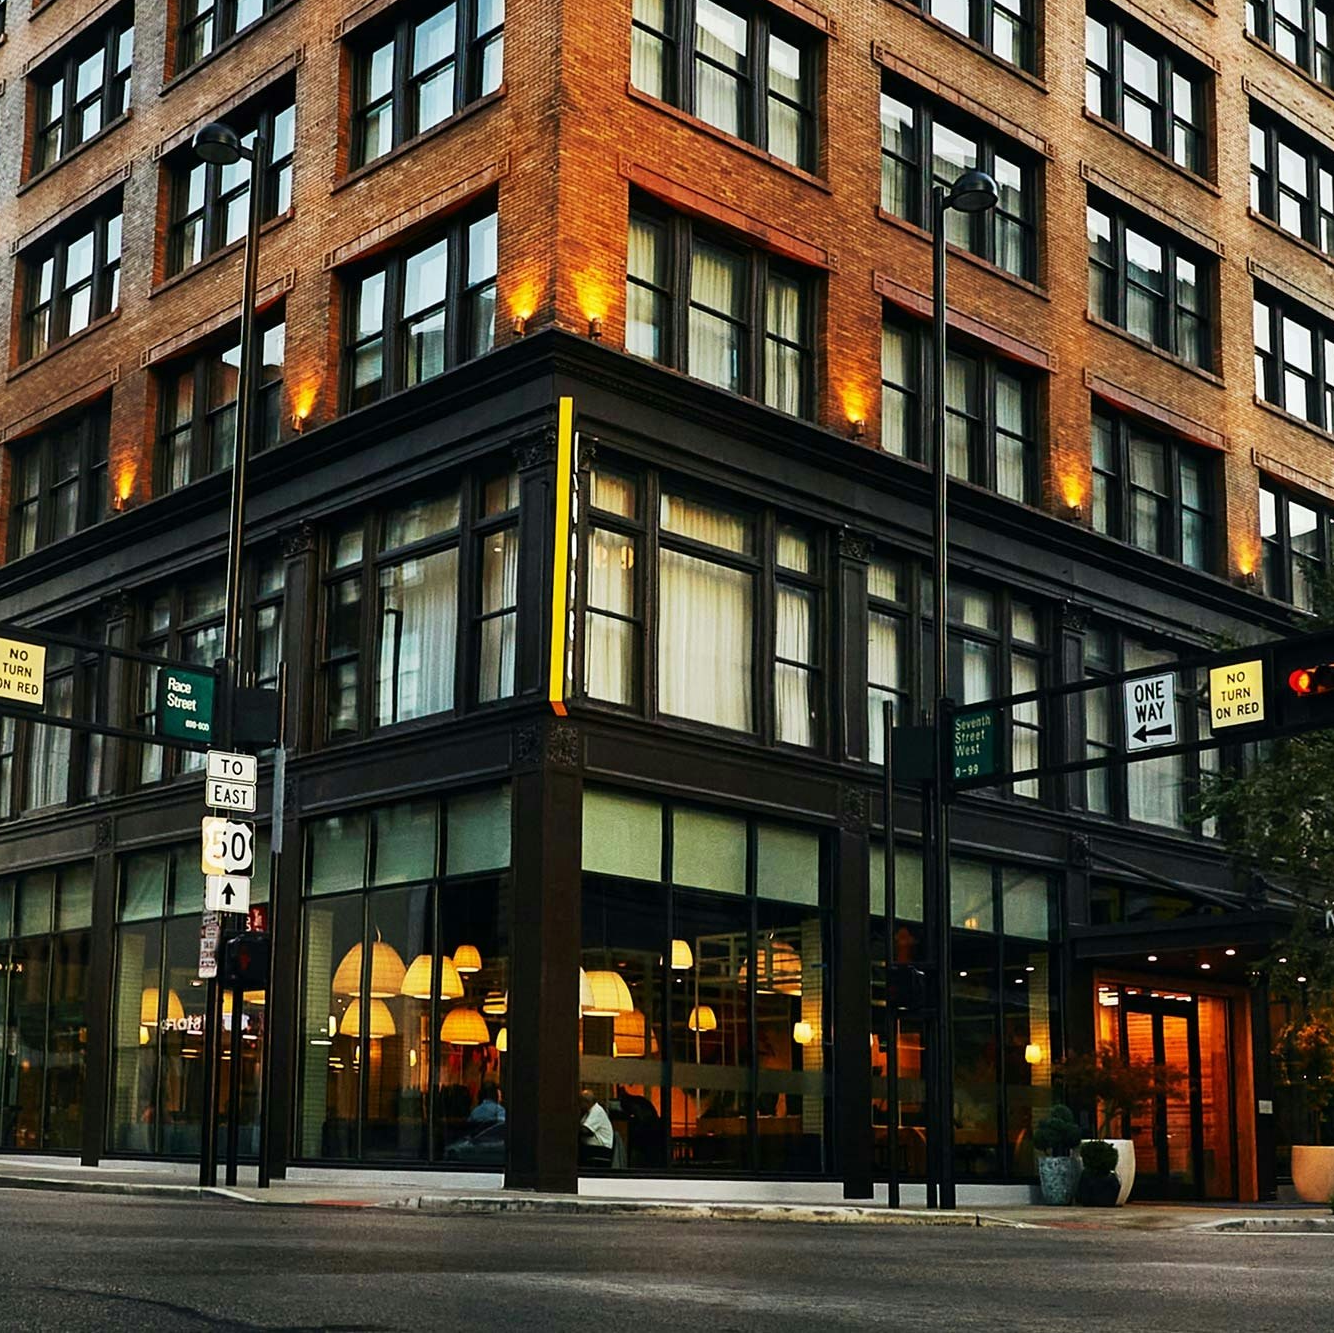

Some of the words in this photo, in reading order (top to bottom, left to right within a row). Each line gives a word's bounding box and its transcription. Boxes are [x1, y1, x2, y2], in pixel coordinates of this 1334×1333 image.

[10, 648, 28, 661] NO
[3, 662, 32, 678] TURN
[1227, 671, 1245, 684] NO
[17, 682, 39, 695] RED
[168, 677, 191, 694] Race
[1134, 680, 1164, 702] ONE
[167, 692, 196, 711] Street
[1221, 687, 1251, 702] TURN
[1135, 701, 1165, 723] WAY
[1216, 707, 1231, 719] ON
[1237, 702, 1259, 716] RED
[955, 714, 991, 731] Seventh
[955, 729, 985, 744] Street
[955, 744, 980, 757] West
[221, 759, 243, 775] TO
[955, 763, 979, 777] 0-99
[214, 784, 247, 805] EAST
[213, 831, 246, 861] 50
